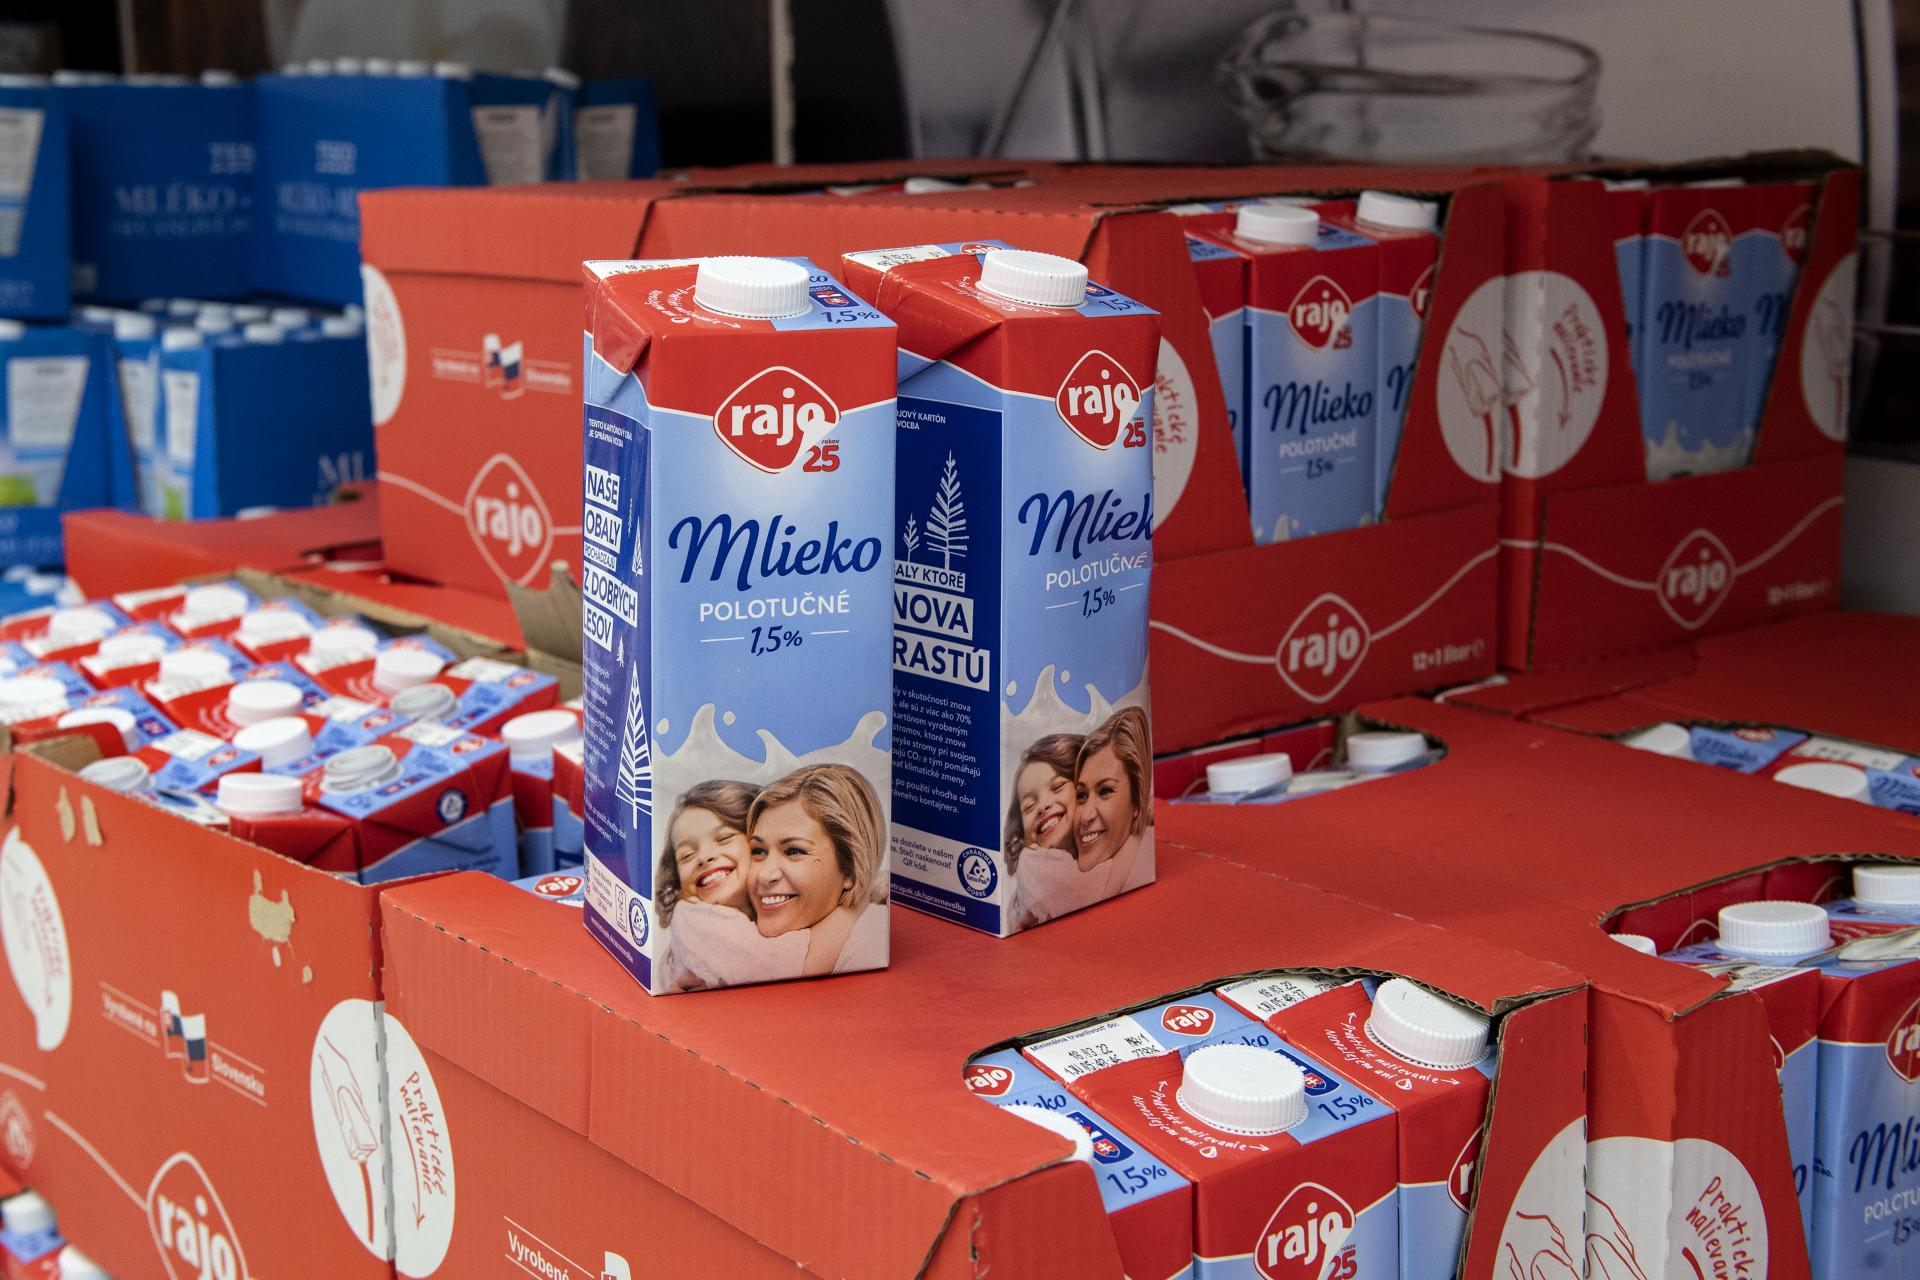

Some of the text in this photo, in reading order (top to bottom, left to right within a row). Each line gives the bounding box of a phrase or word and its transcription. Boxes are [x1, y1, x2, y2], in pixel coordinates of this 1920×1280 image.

[821, 310, 880, 323] 1,5%
[1098, 298, 1144, 311] 1,5%
[1295, 289, 1346, 333] rajo
[1068, 370, 1132, 424] rajo
[1263, 380, 1372, 434] Mlieko
[731, 387, 826, 446] rajo
[918, 412, 946, 424] KARTÓN
[1123, 422, 1147, 448] 25
[1280, 430, 1357, 458] POLOTUČNÉ
[803, 445, 840, 472] 25
[587, 471, 618, 504] NAŠE
[474, 481, 543, 556] rajo
[586, 509, 620, 546] OBALY
[1018, 489, 1153, 559] Mliek
[668, 514, 882, 591] Mlieko
[895, 564, 963, 589] ALY KTORÉ
[1046, 552, 1148, 590] POLOTUČNÉ
[1666, 548, 1727, 605] rajo
[584, 567, 636, 621] Z DOBRÝCH
[700, 589, 850, 622] POLOTUČNÉ
[1083, 587, 1115, 618] 1,5%
[750, 625, 803, 656] 1,5%
[1288, 614, 1360, 676] rajo
[893, 636, 984, 683] RASTÚ
[908, 689, 949, 706] skutočnosti
[949, 701, 971, 712] znova
[928, 721, 968, 737] vyrobeným
[941, 709, 954, 719] ako
[955, 713, 972, 725] 70%
[912, 740, 937, 754] stromy
[949, 750, 976, 763] svojom
[905, 761, 940, 778] klimatické
[945, 762, 981, 778] pomáhajú
[959, 795, 976, 805] obal
[902, 858, 913, 867] QR
[538, 877, 578, 893] rajo
[1167, 1008, 1210, 1031] rajo
[964, 1068, 1008, 1096] rajo
[1375, 1058, 1440, 1084] nalievanie
[1318, 1094, 1374, 1122] 1,5%
[400, 1085, 432, 1194] nalievanie
[406, 1071, 447, 1196] Praktické
[1181, 1126, 1247, 1151] nalievanie
[1107, 1164, 1167, 1195] 1,5%
[158, 1194, 237, 1280] rajo
[1267, 1202, 1343, 1267] rajo
[507, 1230, 570, 1280] Vyrobené
[1328, 1250, 1357, 1280] 25
